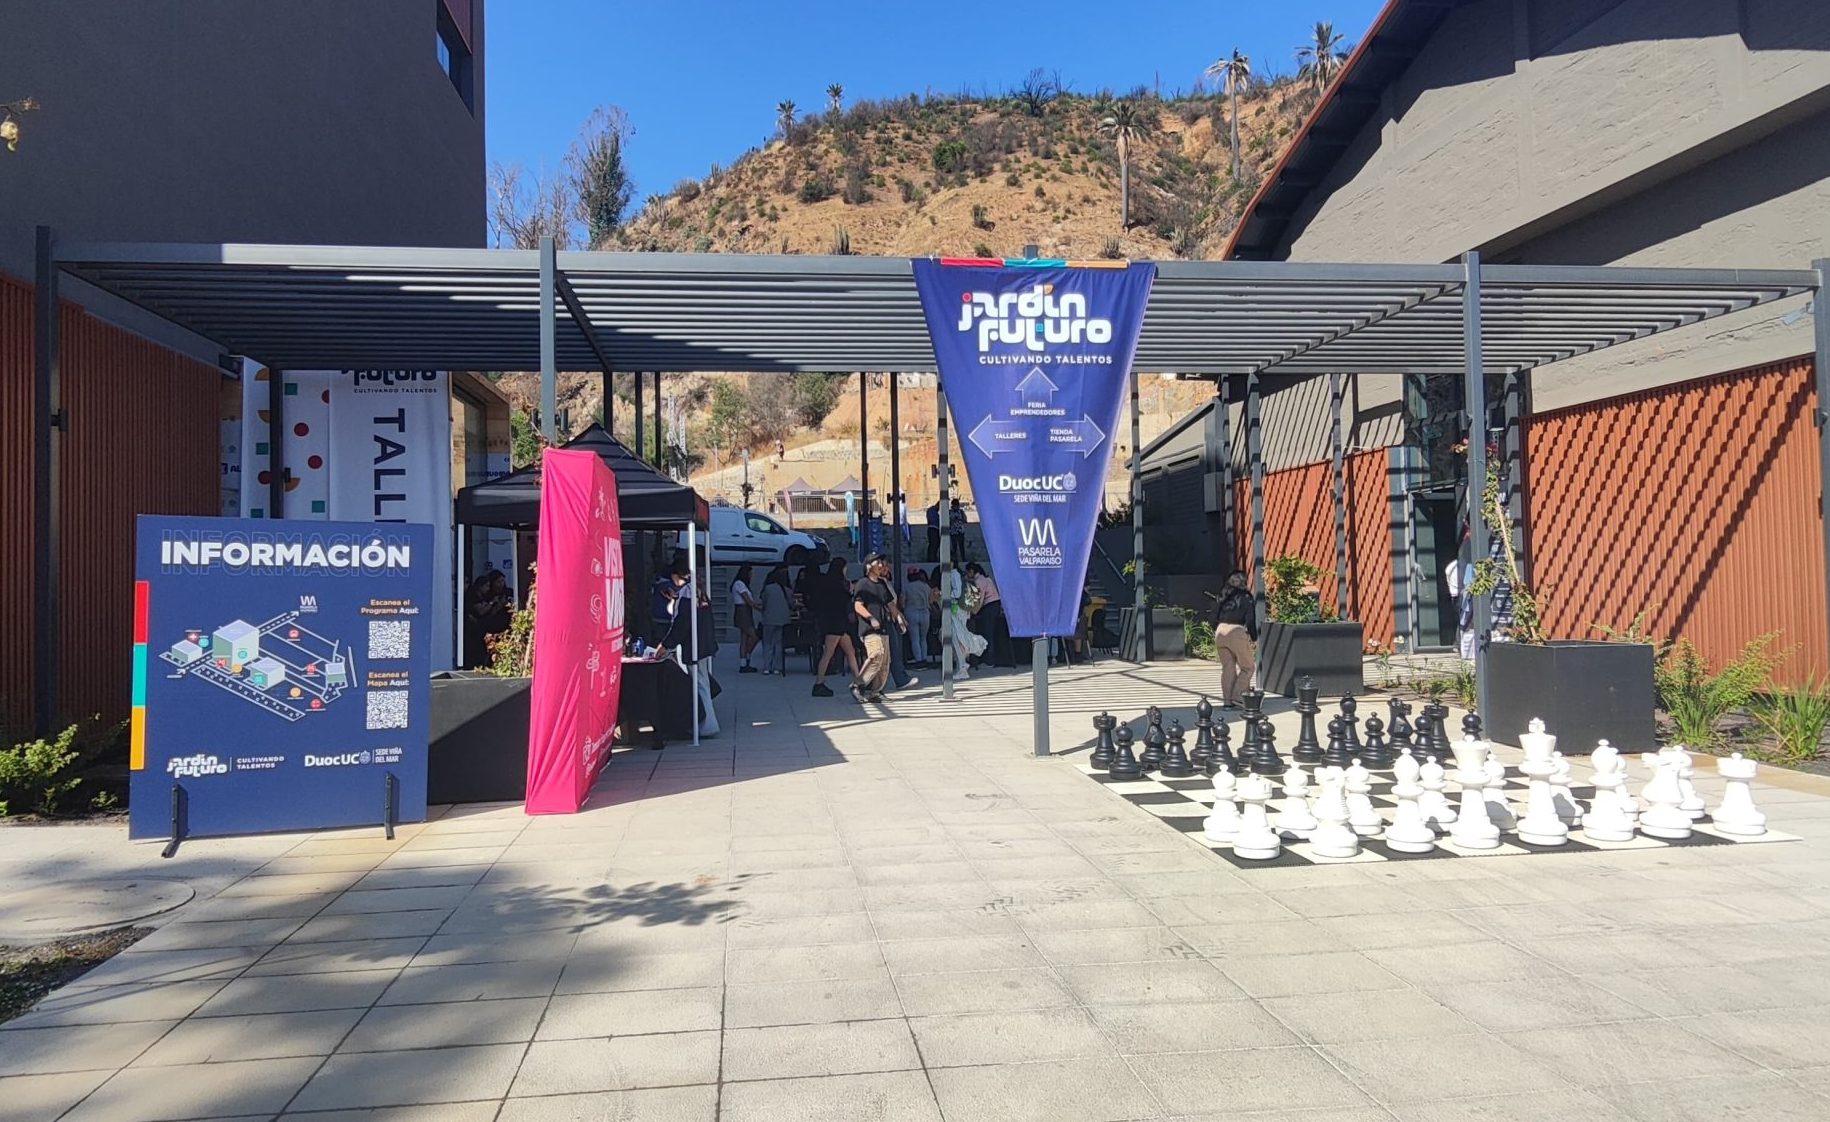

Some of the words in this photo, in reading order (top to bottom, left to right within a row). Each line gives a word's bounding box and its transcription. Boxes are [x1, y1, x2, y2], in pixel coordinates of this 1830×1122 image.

[979, 355, 1052, 365] CULTIVANDO
[1056, 355, 1112, 365] TALENTOS
[1028, 401, 1046, 409] FERIA
[1050, 435, 1083, 443] PASARELA
[1014, 494, 1028, 502] SEDE
[1029, 493, 1042, 502] VIÑA
[1042, 494, 1052, 502] DEL
[1053, 494, 1067, 502] MAR
[161, 539, 410, 567] INFORMACIÓN
[1018, 547, 1061, 556] PASARELA
[361, 607, 398, 615] Programa
[368, 671, 400, 679] Escanea
[389, 746, 402, 755] VIÑA
[237, 756, 285, 764] CULTIVANDO
[375, 755, 386, 763] DEL
[386, 755, 399, 763] MAR
